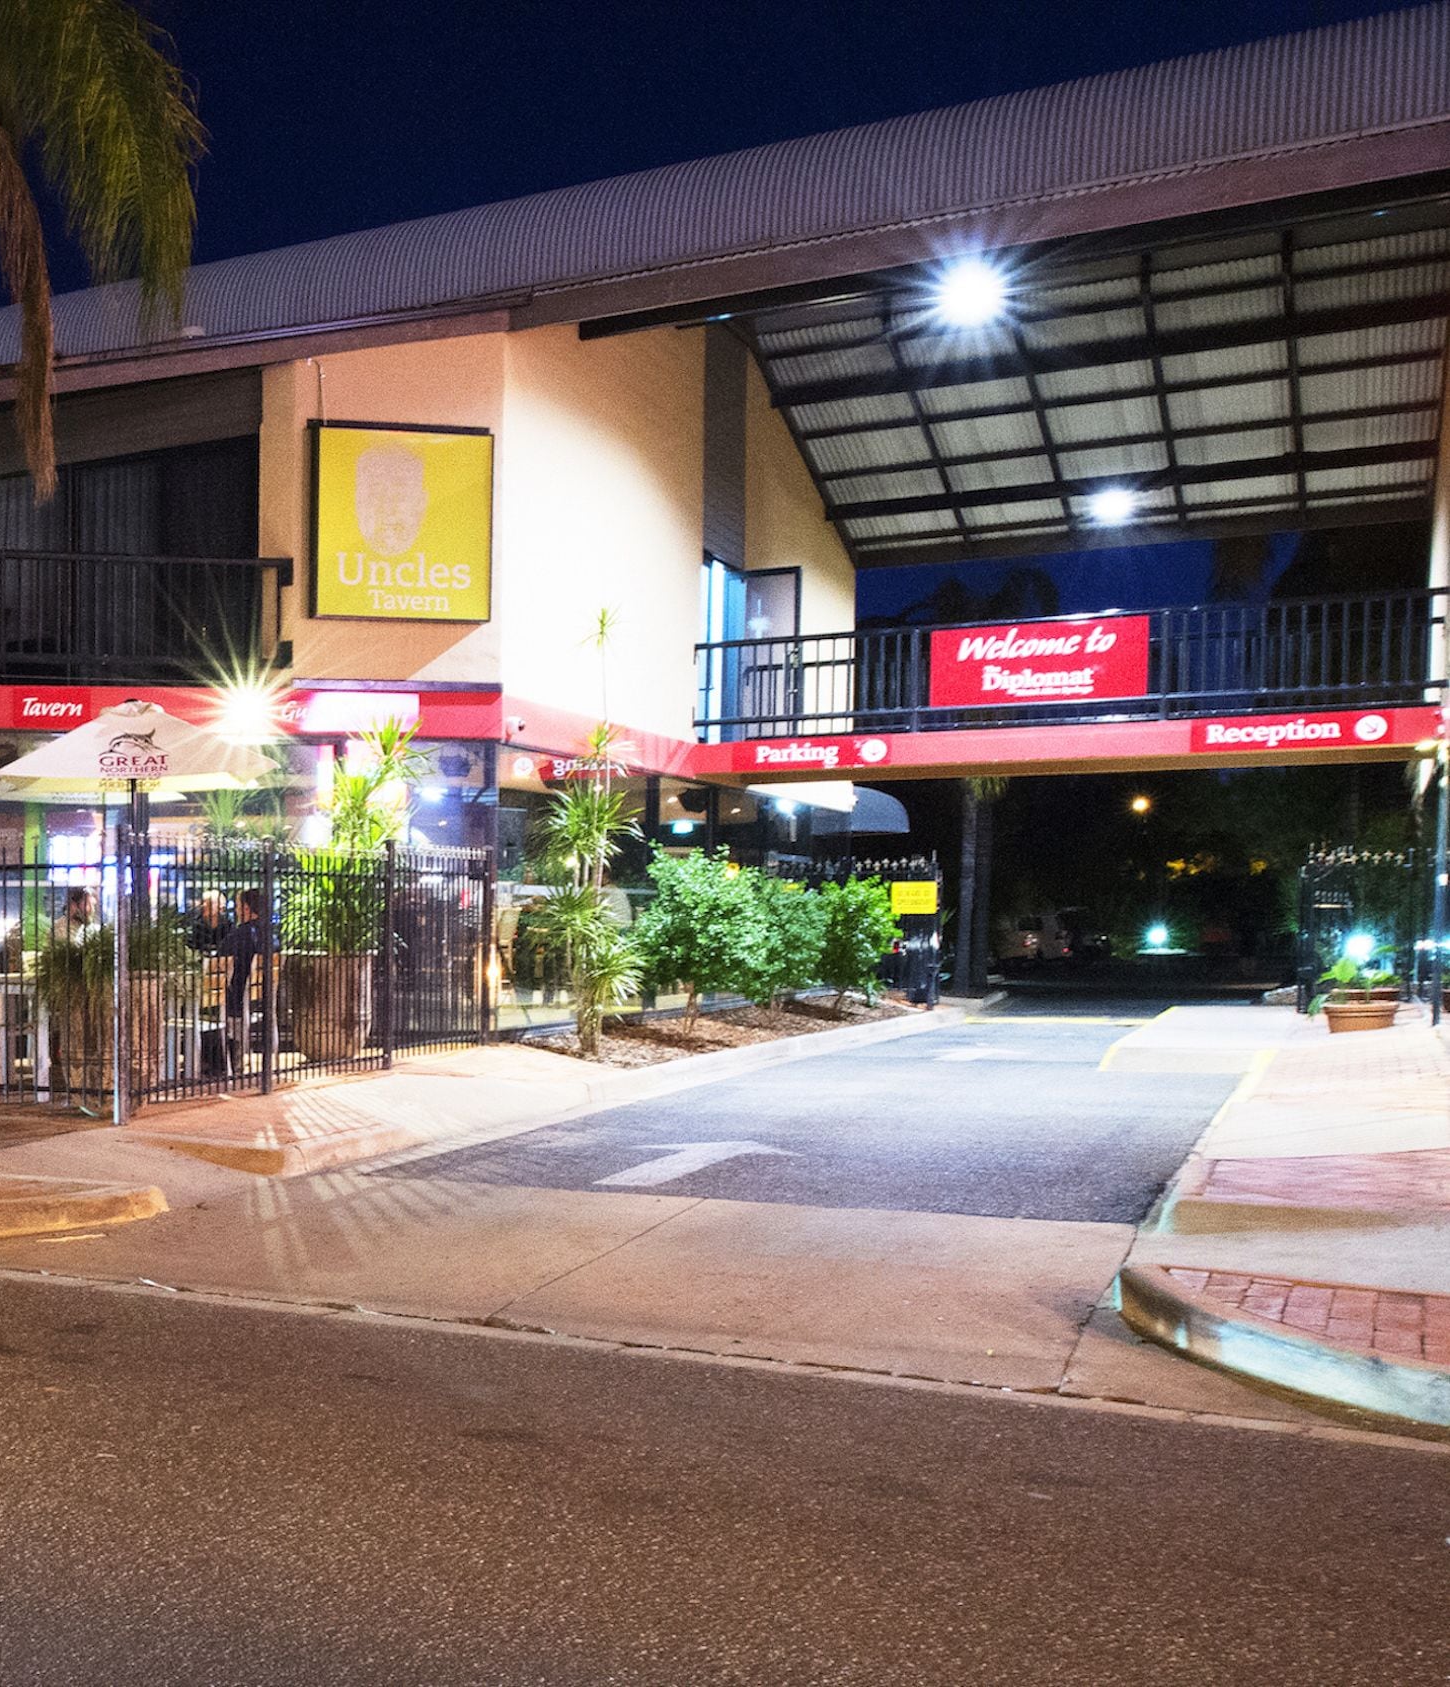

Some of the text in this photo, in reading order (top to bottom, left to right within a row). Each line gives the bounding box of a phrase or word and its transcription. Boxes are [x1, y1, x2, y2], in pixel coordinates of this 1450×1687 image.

[336, 552, 471, 589] Uncles
[368, 589, 450, 612] Tavern
[956, 626, 1117, 662] Welcome to
[982, 668, 1094, 694] Diplomat
[22, 697, 83, 717] Tavern
[1206, 719, 1341, 747] Reception
[99, 754, 169, 766] GREAT
[755, 742, 839, 769] Parking
[100, 765, 168, 773] NORTHERN
